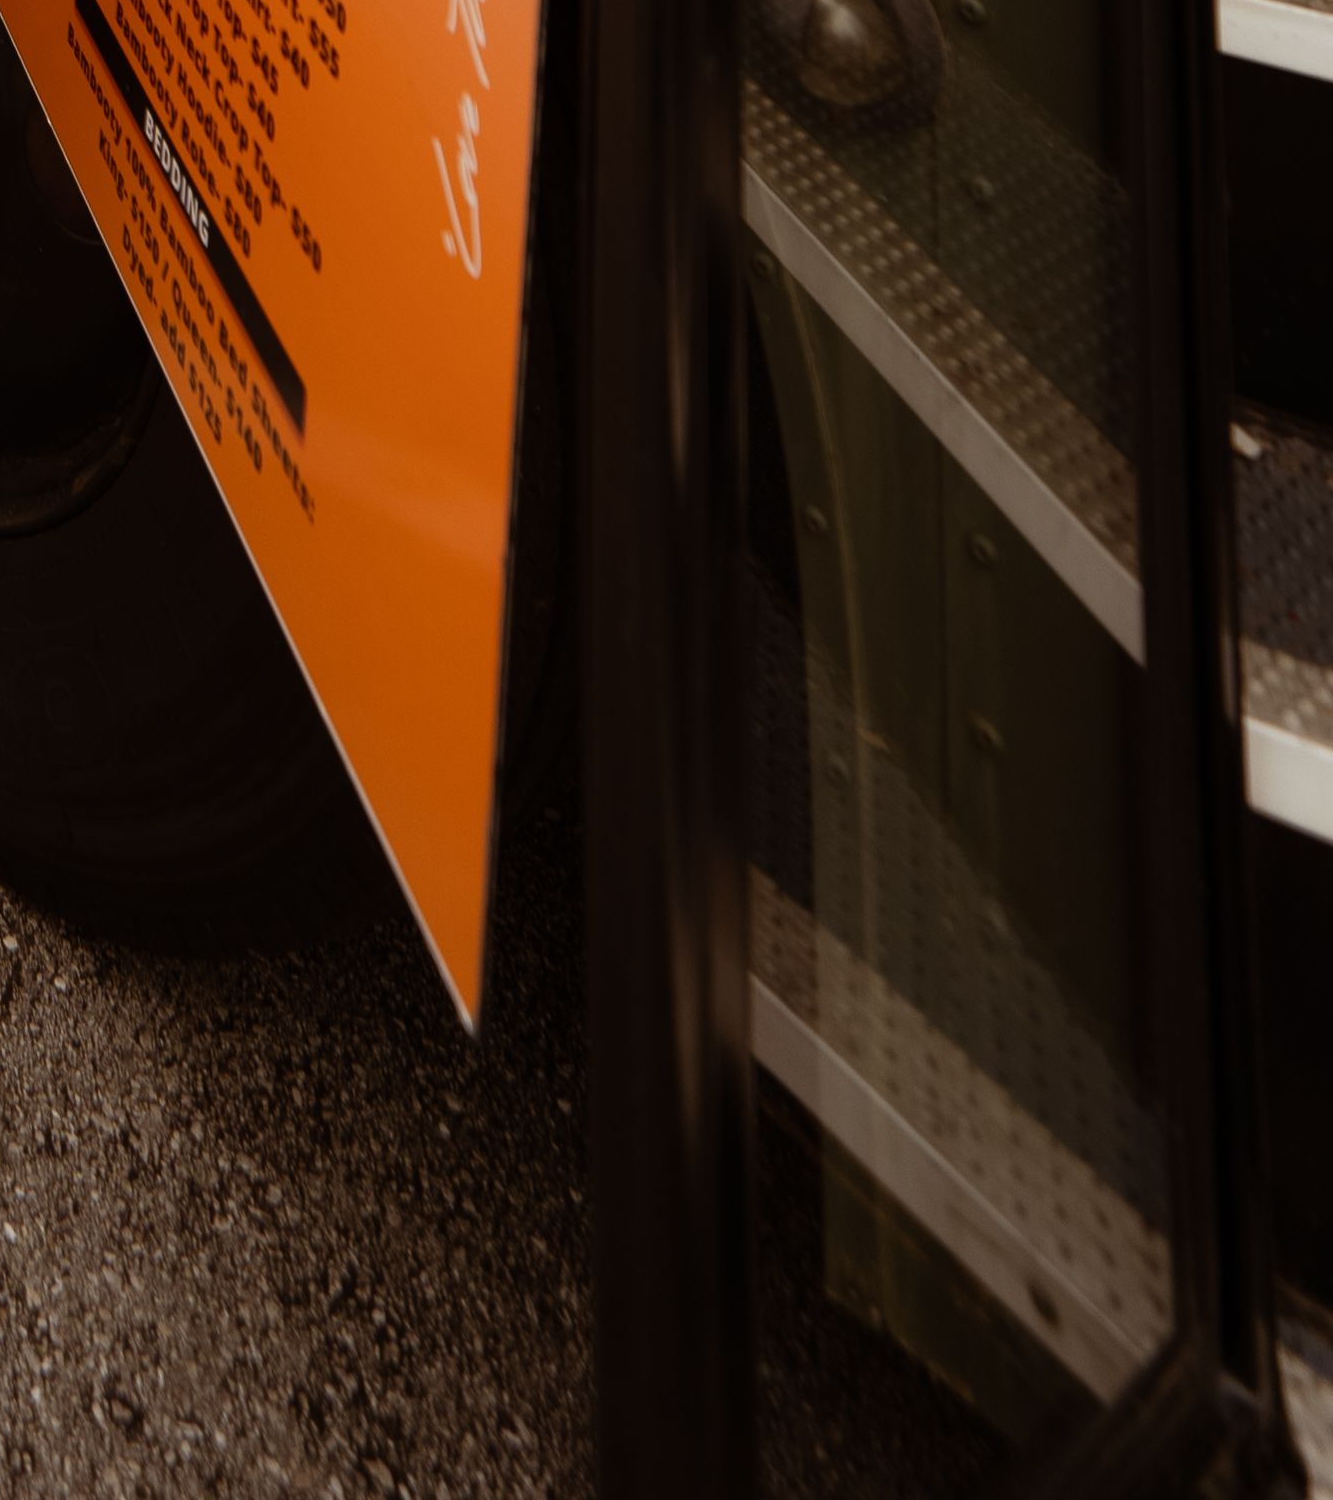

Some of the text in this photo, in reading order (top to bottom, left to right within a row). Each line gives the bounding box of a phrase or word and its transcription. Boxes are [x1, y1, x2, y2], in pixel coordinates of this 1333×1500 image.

[250, 35, 277, 95] $45
[280, 28, 309, 88] $40
[308, 17, 339, 78] $55
[247, 81, 274, 141] $40
[145, 109, 208, 246] BEDDING
